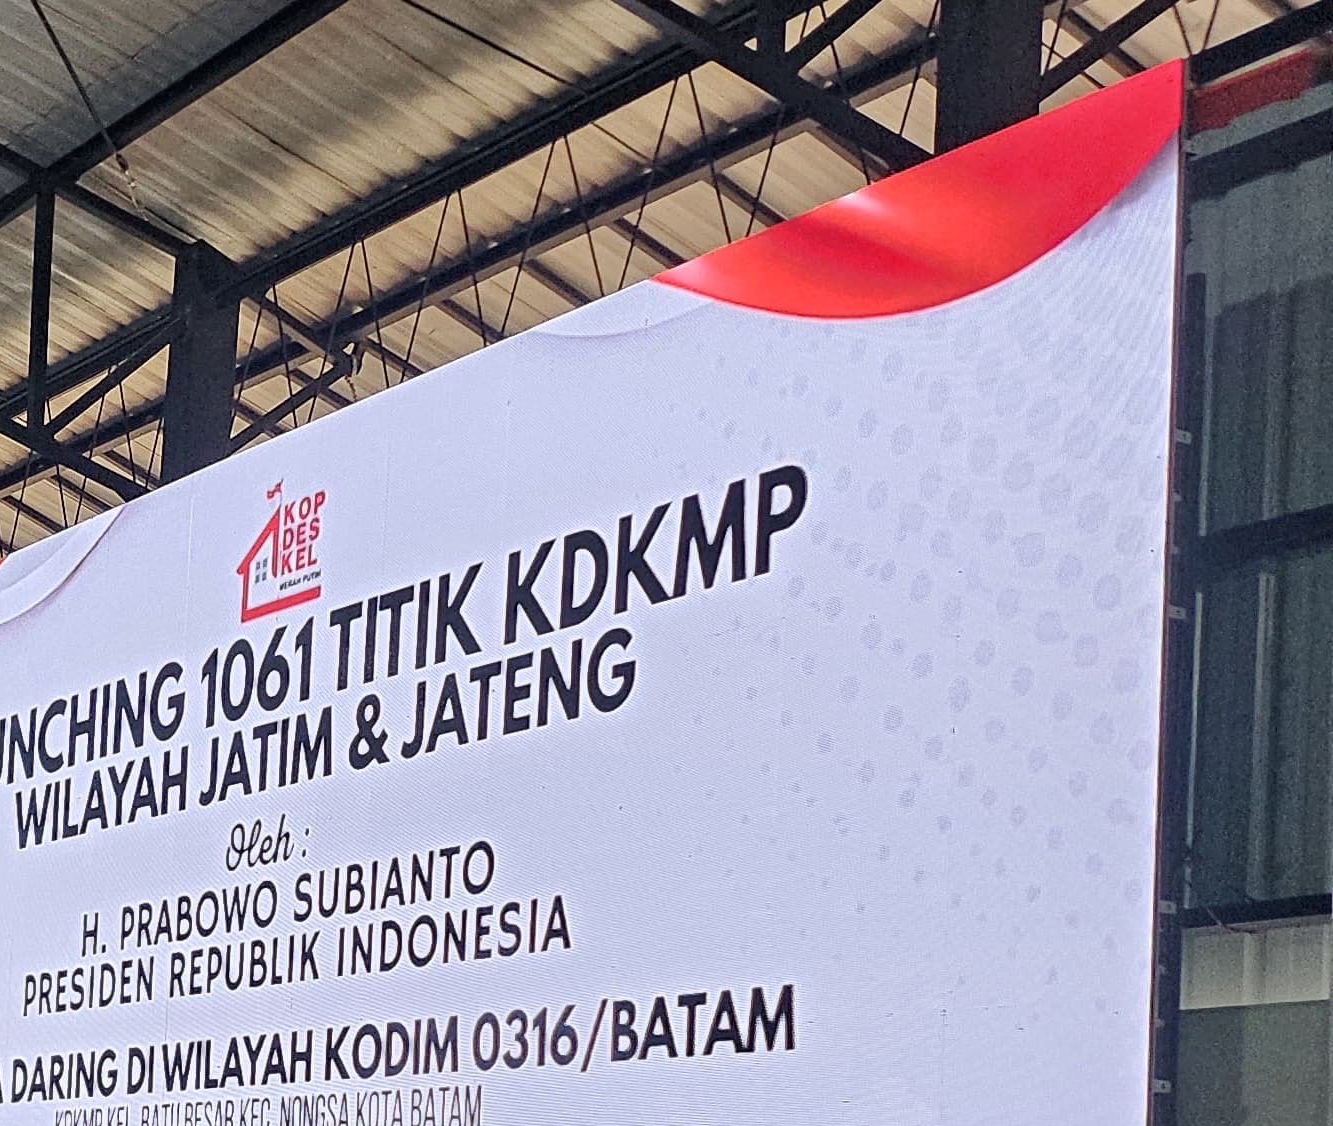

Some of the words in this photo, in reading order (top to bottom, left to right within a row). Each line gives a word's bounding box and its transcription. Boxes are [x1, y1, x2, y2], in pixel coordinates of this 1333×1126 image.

[280, 543, 318, 576] KEL
[282, 516, 320, 551] DES
[283, 491, 326, 526] KOP
[200, 616, 314, 729] 1061
[329, 561, 484, 692] TITIK
[503, 465, 808, 646] KDKMP
[15, 745, 189, 850] WILAYAH
[198, 705, 332, 807] JATIM
[348, 693, 390, 771] &
[400, 627, 637, 759] JATENG
[81, 912, 107, 958] H.
[120, 880, 278, 951] PRABOWO
[293, 840, 495, 923] SUBIANTO
[225, 813, 295, 872] Oleh
[23, 955, 155, 1017] PRESIDEN
[169, 930, 321, 998] REPUBLIK
[337, 895, 572, 977] INDONESIA
[10, 1048, 118, 1104] DARING
[126, 1045, 155, 1095] DI
[161, 1029, 314, 1093] WILAYAH
[324, 1015, 459, 1081] KODIM
[472, 983, 796, 1073] 0316/BATAM
